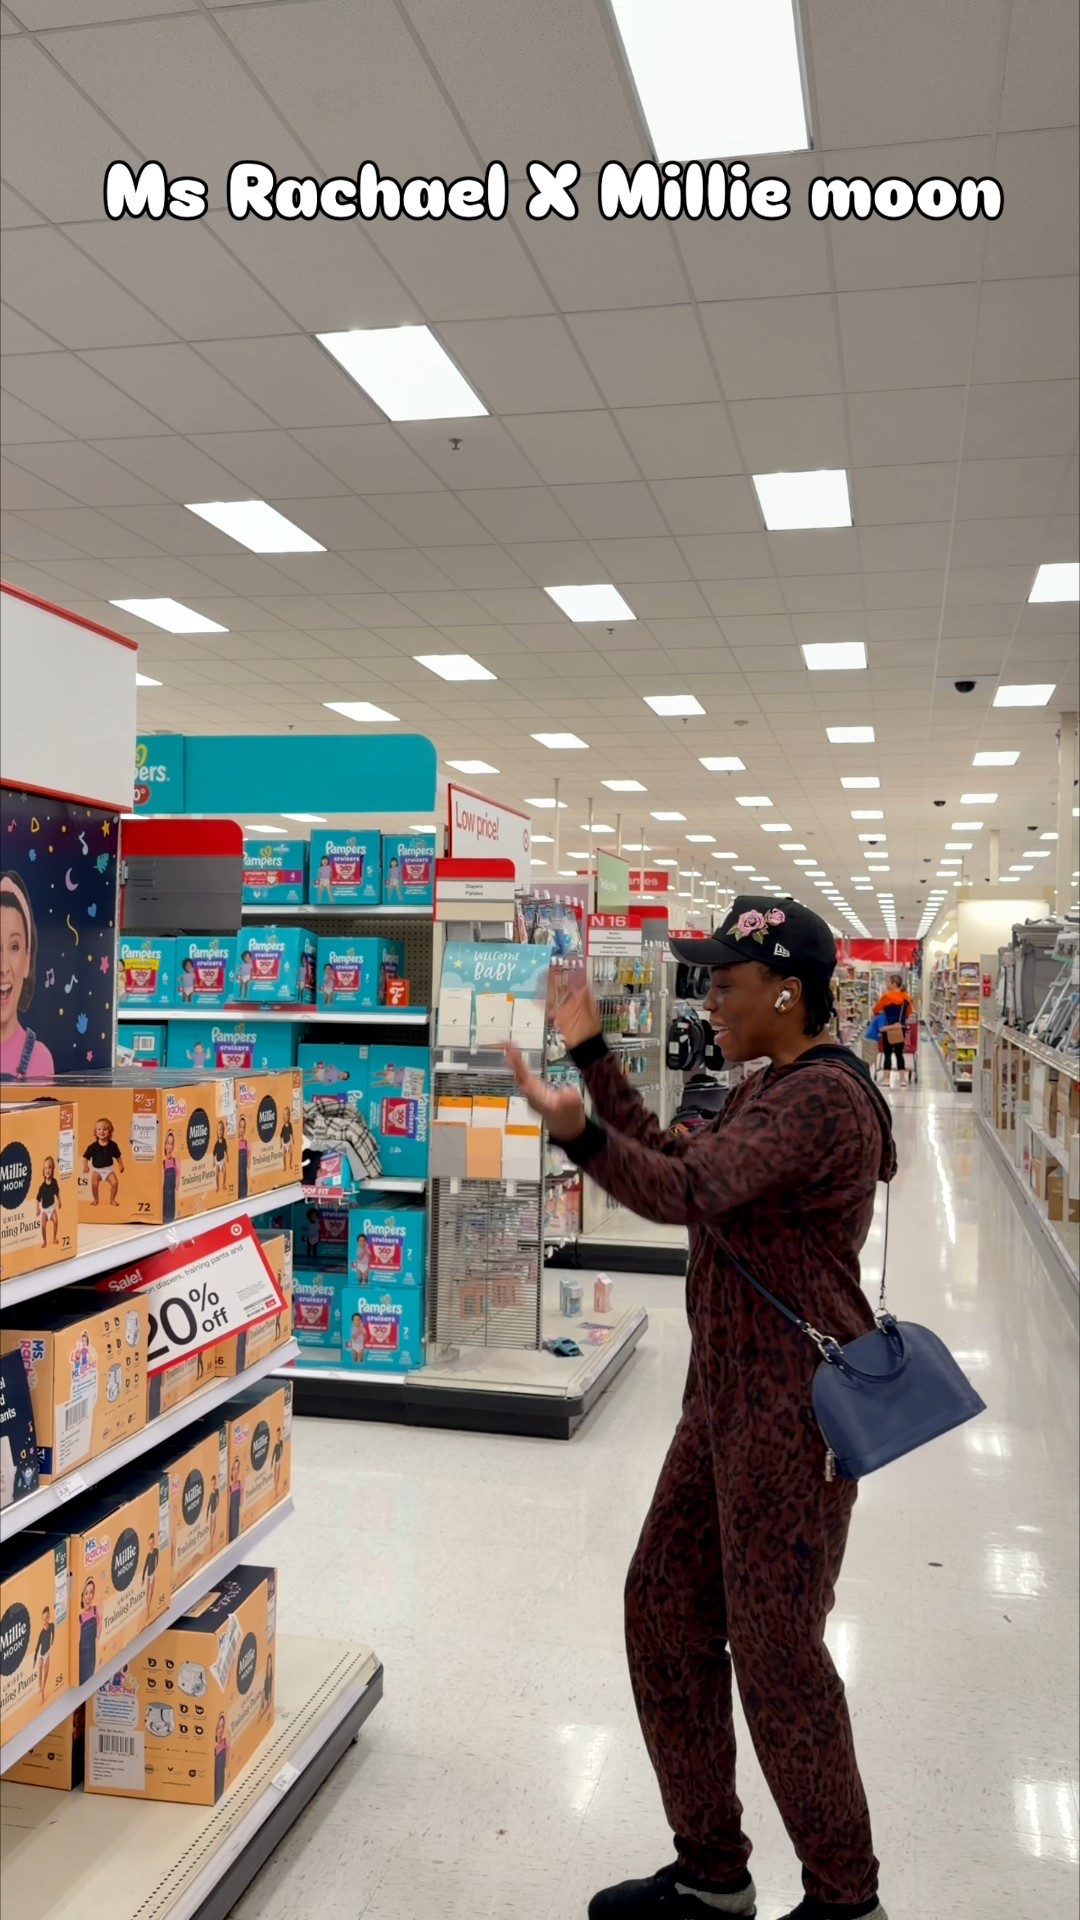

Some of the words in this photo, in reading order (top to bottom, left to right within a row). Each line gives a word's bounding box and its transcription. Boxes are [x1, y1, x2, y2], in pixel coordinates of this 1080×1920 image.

[455, 801, 475, 832] Low
[477, 811, 499, 840] price!
[326, 840, 367, 855] Pampers
[397, 843, 434, 857] Pampers
[366, 866, 373, 874] 5
[591, 915, 604, 927] N
[608, 915, 626, 927] 16
[121, 944, 162, 959] Pampers
[189, 943, 229, 960] Pampers
[248, 938, 286, 952] Pampers
[284, 961, 289, 969] 6
[329, 951, 364, 965] Pampers
[162, 973, 168, 981] 6
[229, 971, 234, 979] 6
[211, 1026, 257, 1044] Pampers
[261, 1057, 268, 1066] 3
[259, 1109, 276, 1122] Millie
[189, 1124, 208, 1139] Millie
[191, 1138, 206, 1147] MOON
[252, 1155, 271, 1165] Training
[270, 1151, 283, 1161] Pants
[0, 1162, 28, 1181] Millie
[181, 1173, 202, 1185] Training
[201, 1169, 216, 1181] Pants
[3, 1181, 24, 1192] MOON
[317, 1187, 329, 1195] FIT
[138, 1202, 151, 1212] 72
[3, 1213, 25, 1224] UNISEX
[19, 1220, 41, 1234] Pants
[363, 1219, 407, 1236] Pampers
[62, 1236, 70, 1246] 72
[407, 1249, 413, 1257] 7
[146, 1287, 156, 1295] on
[156, 1273, 185, 1290] diapers,
[185, 1261, 211, 1276] training
[210, 1252, 230, 1265] pants
[230, 1245, 244, 1255] and
[108, 1269, 143, 1292] Sale!
[335, 1309, 340, 1317] 6
[358, 1297, 402, 1315] Pampers
[202, 1306, 229, 1333] off
[403, 1327, 408, 1335] 7
[253, 1434, 269, 1453] Millie
[185, 1484, 202, 1506] Millie
[177, 1536, 197, 1557] Training
[196, 1526, 209, 1541] Pants
[86, 1541, 109, 1564] Rachel
[114, 1545, 137, 1569] Millie
[117, 1559, 135, 1577] MOON
[104, 1603, 129, 1628] Training
[129, 1591, 146, 1608] Pants
[0, 1622, 27, 1650] Millie
[3, 1639, 23, 1660] MOON
[239, 1648, 255, 1674] Millie
[3, 1672, 23, 1692] UNISEX
[18, 1672, 38, 1692] Pants
[55, 1673, 63, 1687] 56
[108, 1685, 136, 1695] Rachel
[231, 1705, 249, 1732] Training
[249, 1690, 262, 1710] Pants
